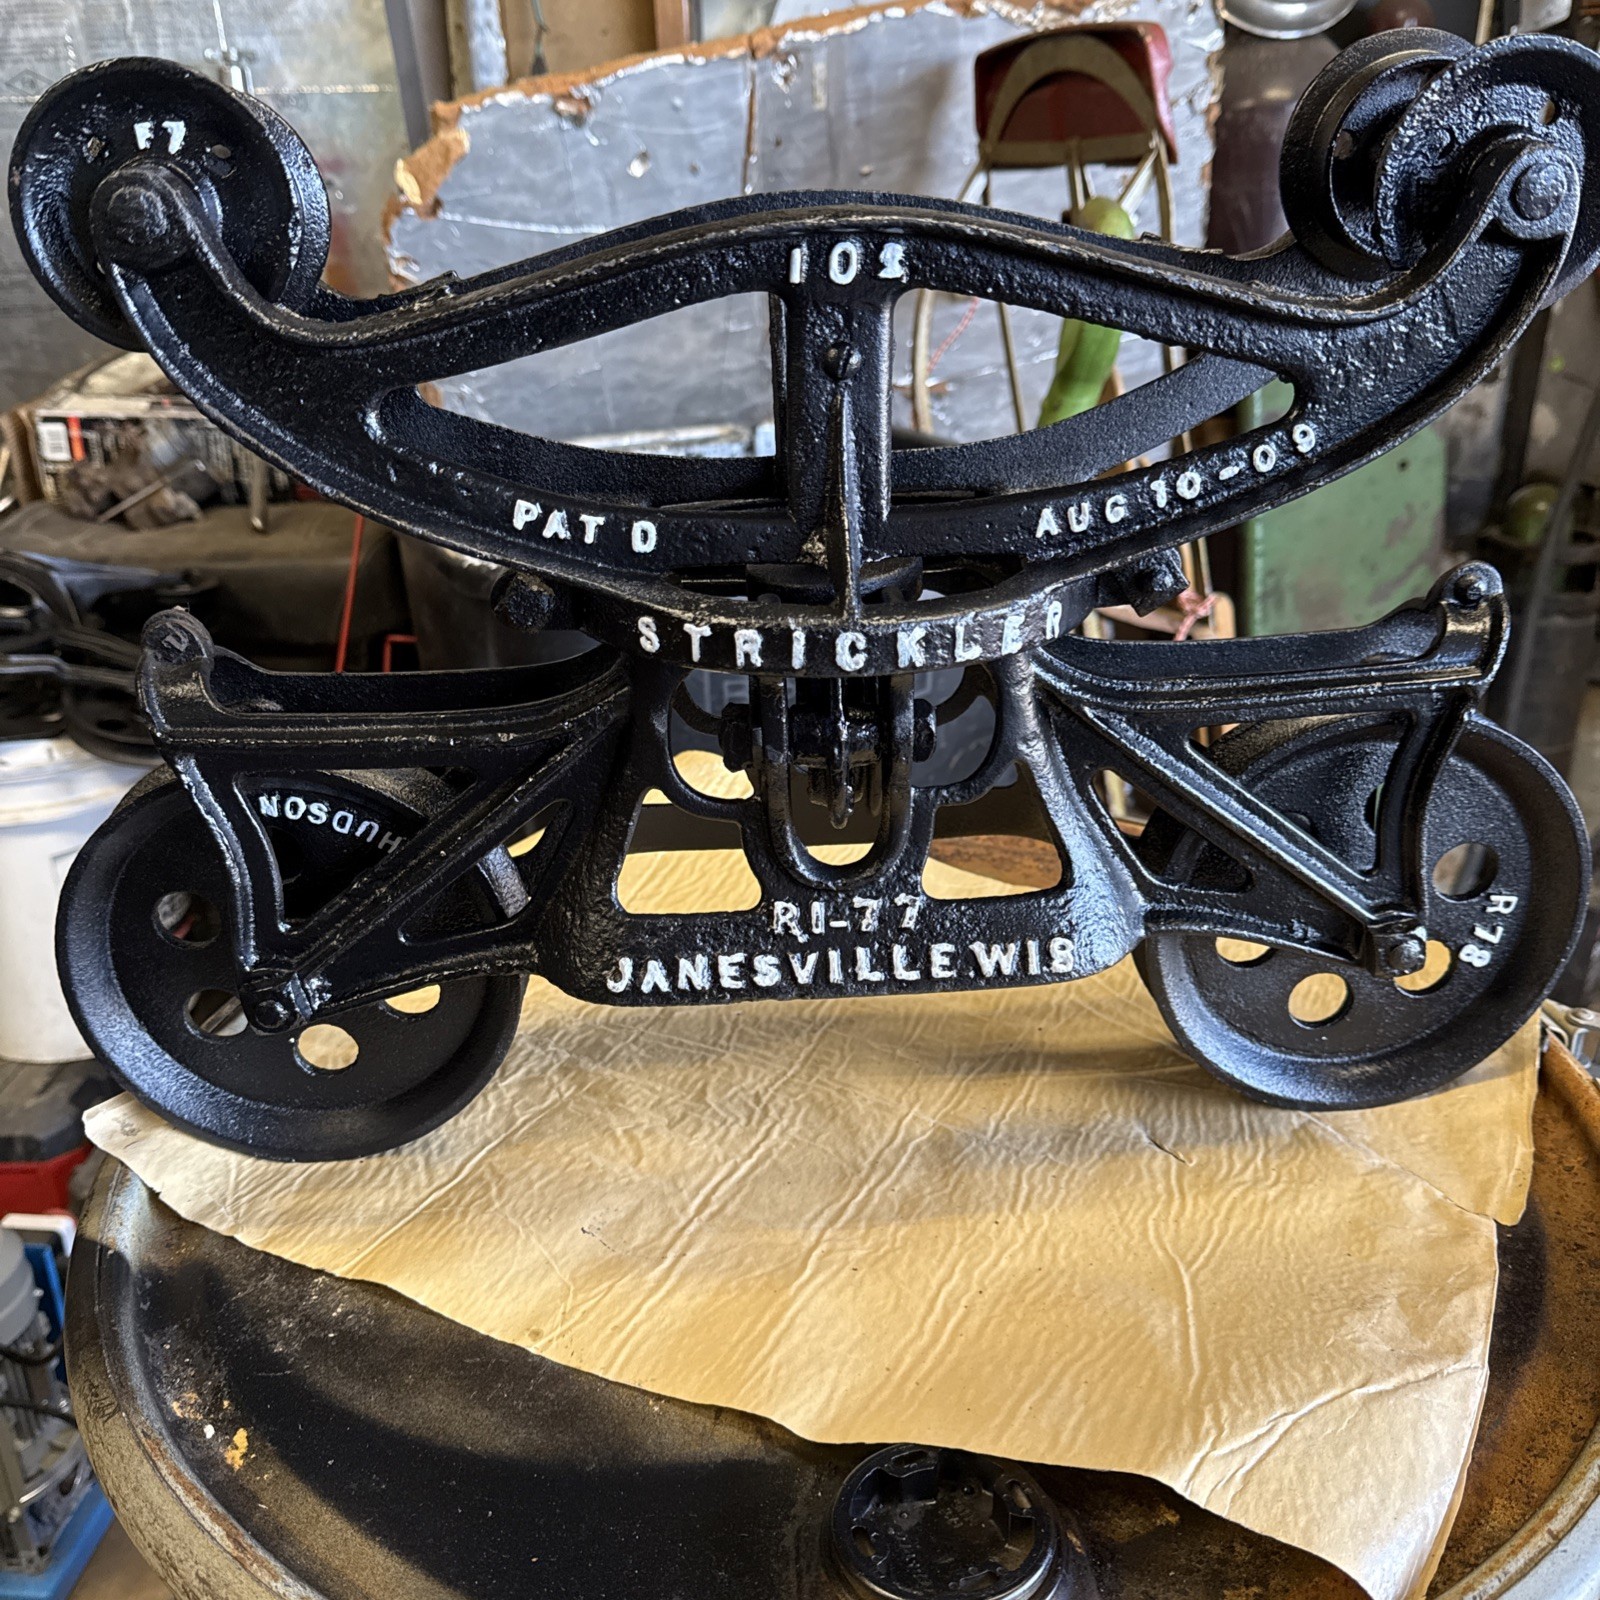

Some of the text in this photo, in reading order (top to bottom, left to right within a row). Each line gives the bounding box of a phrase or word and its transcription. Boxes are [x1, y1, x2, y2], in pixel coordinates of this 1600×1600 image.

[133, 120, 187, 155] F7
[512, 499, 606, 545] PAT
[1035, 494, 1128, 539] AUG
[637, 600, 1064, 672] STRICKLER
[258, 794, 401, 854] HUDSON
[1458, 894, 1519, 968] R78
